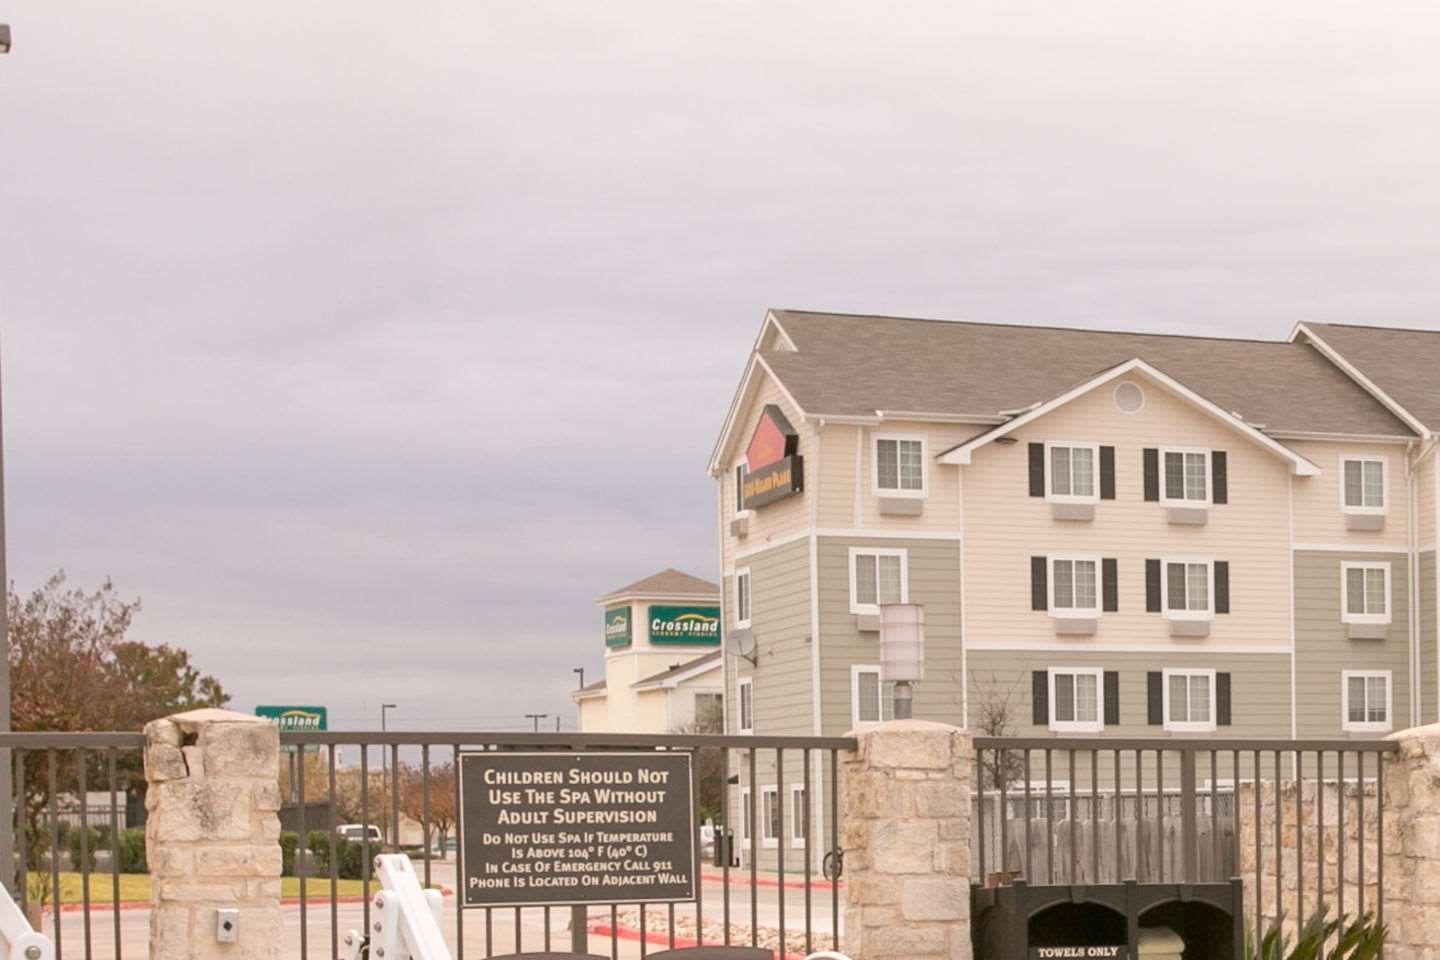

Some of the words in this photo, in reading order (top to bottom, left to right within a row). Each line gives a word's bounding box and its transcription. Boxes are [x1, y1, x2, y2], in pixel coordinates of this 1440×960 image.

[652, 618, 718, 632] Crossland
[483, 768, 564, 785] CHILDREN
[568, 768, 633, 785] SHOULD
[637, 768, 670, 784] NOT
[488, 789, 522, 805] USE
[524, 788, 555, 805] THE
[559, 788, 591, 804] SPA
[593, 788, 667, 804] WITHOUT
[497, 809, 550, 825] ADULT
[553, 807, 657, 825] SUPERVISION
[482, 832, 502, 845] DO
[504, 832, 529, 845] NOT
[531, 832, 556, 845] USE
[558, 831, 582, 844] SPA
[583, 831, 595, 844] IF
[596, 831, 673, 843] TEMPERATURE
[511, 847, 524, 859] IS
[526, 846, 566, 859] ABOVE
[597, 845, 605, 857] F
[634, 844, 648, 858] C)
[485, 862, 499, 874] IN
[501, 861, 532, 874] CASE
[534, 860, 551, 873] OF
[553, 860, 622, 873] EMERGENCY
[623, 859, 651, 871] CALL
[652, 861, 673, 873] 911
[469, 876, 511, 889] PHONE
[513, 876, 526, 888] IS
[528, 875, 579, 888] LOCATED
[581, 874, 600, 887] ON
[601, 874, 657, 887] ADJACENT
[657, 872, 689, 885] WALL
[1038, 947, 1085, 958] TOWELS
[1087, 946, 1119, 957] ONLY
